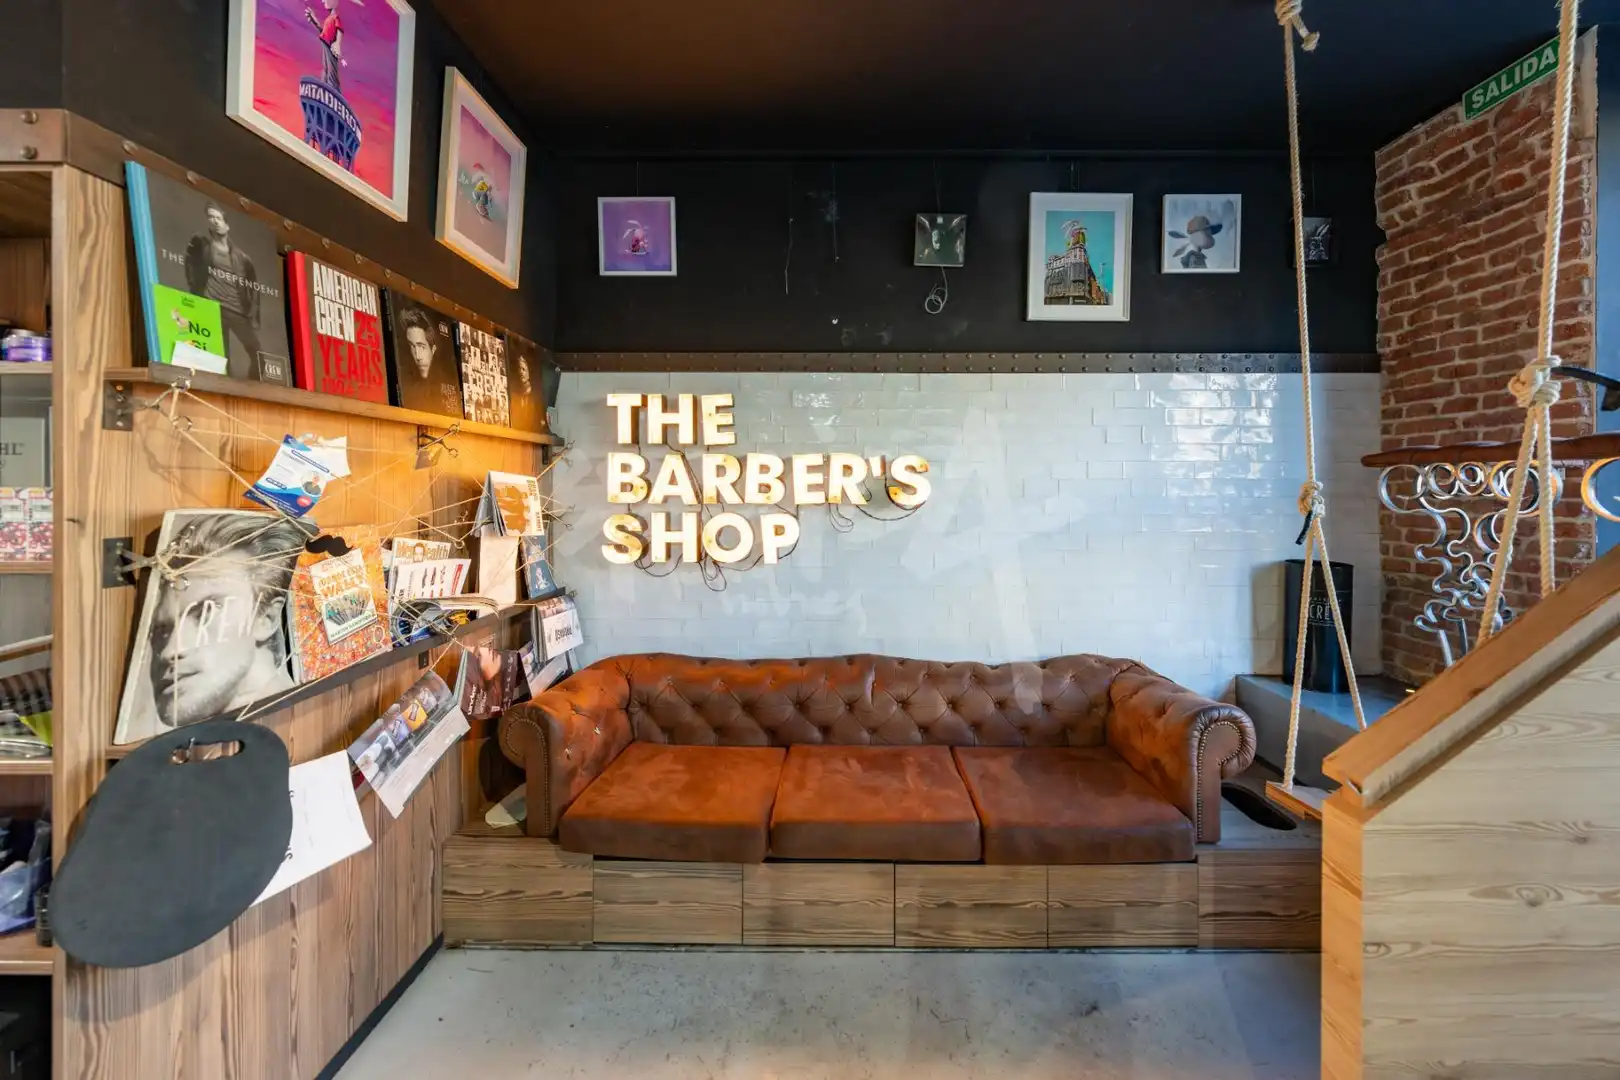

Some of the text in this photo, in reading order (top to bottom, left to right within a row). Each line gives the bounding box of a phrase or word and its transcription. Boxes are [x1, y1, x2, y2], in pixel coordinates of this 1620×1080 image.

[1471, 46, 1556, 109] SALIDA
[162, 248, 185, 266] THE
[312, 261, 378, 317] AMERICAN
[188, 320, 211, 338] No
[314, 295, 356, 344] CREW
[354, 314, 380, 351] 25
[316, 334, 384, 388] YEARS
[606, 393, 737, 445] THE
[606, 452, 932, 507] BARBER'S
[601, 512, 801, 564] SHOP
[177, 591, 263, 652] CREW
[1309, 604, 1332, 620] CRE
